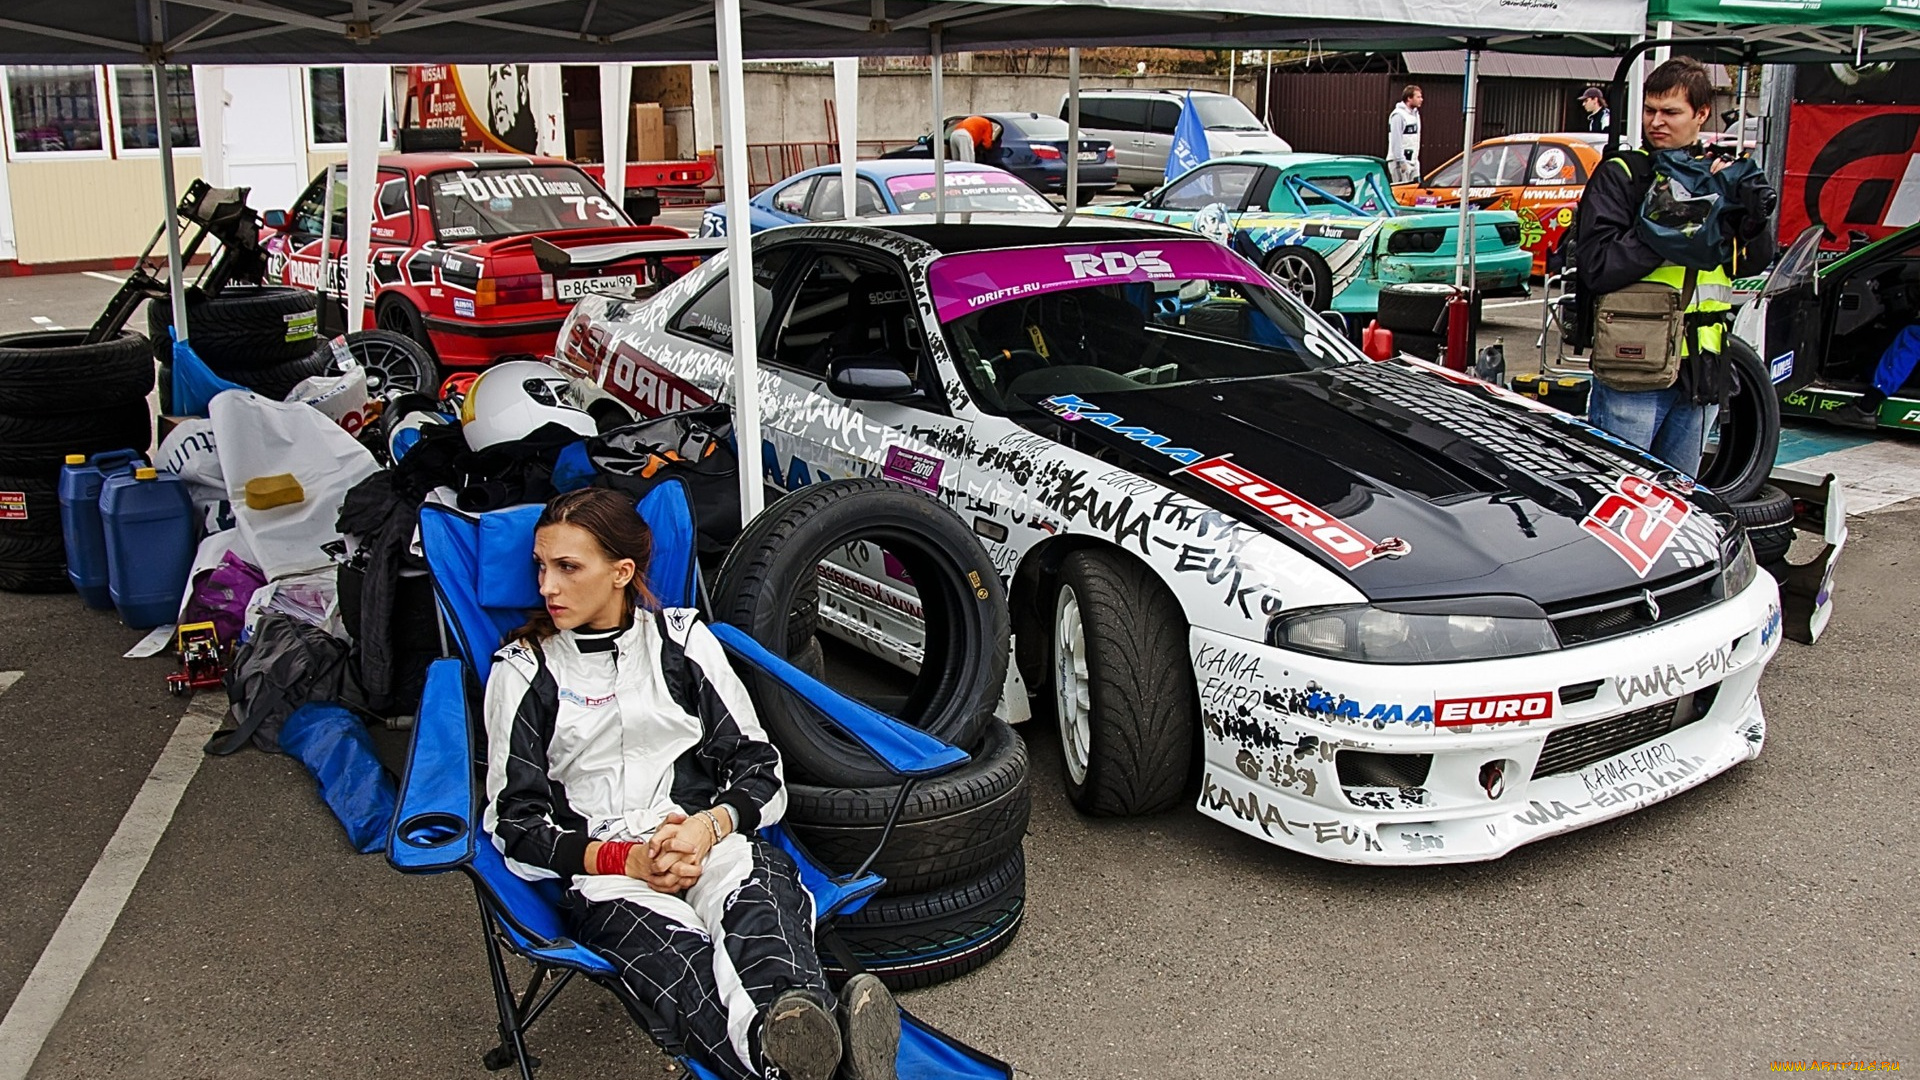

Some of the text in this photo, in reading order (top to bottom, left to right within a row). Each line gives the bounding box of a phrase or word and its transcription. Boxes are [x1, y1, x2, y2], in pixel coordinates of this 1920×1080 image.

[421, 67, 447, 82] NISSAN
[434, 101, 457, 115] garage
[457, 171, 547, 202] burn
[560, 195, 618, 221] 73
[1325, 226, 1344, 238] burn
[1063, 250, 1173, 279] RDS
[1147, 271, 1176, 279] Запад
[619, 276, 633, 287] 99
[868, 288, 910, 304] sparc
[967, 281, 1041, 308] VDRIFTE.RU
[698, 313, 734, 336] Aleksee
[911, 461, 935, 477] 2010
[1047, 394, 1369, 556] KAMA EURO
[1098, 469, 1158, 496] EURO
[1306, 690, 1547, 723] KAMA EURO
[1579, 742, 1677, 794] KAMA-EURO
